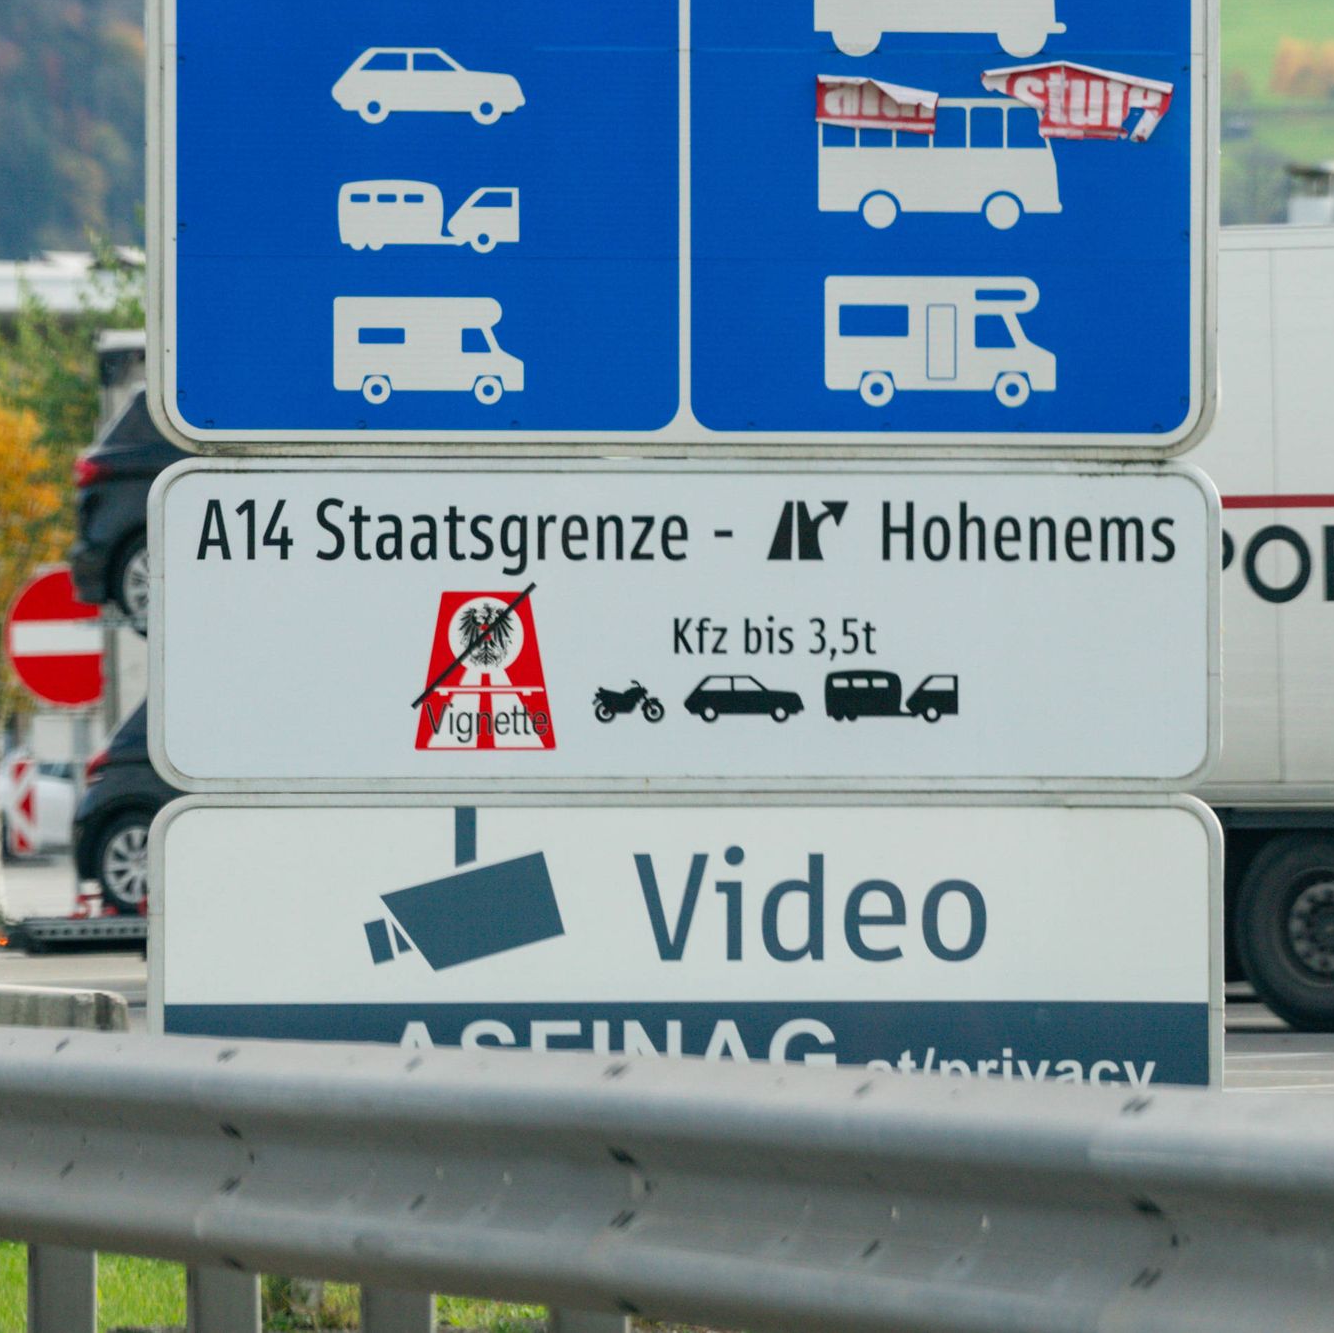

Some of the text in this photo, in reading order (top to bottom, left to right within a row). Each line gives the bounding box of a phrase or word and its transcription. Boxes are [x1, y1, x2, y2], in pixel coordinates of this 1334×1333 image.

[196, 499, 294, 562] A14
[316, 497, 690, 577] Staatsgrenze
[882, 500, 1177, 564] Hohenems
[673, 616, 878, 661] Kfz bis 3,5t
[425, 702, 549, 744] Vignette
[633, 846, 988, 963] Video
